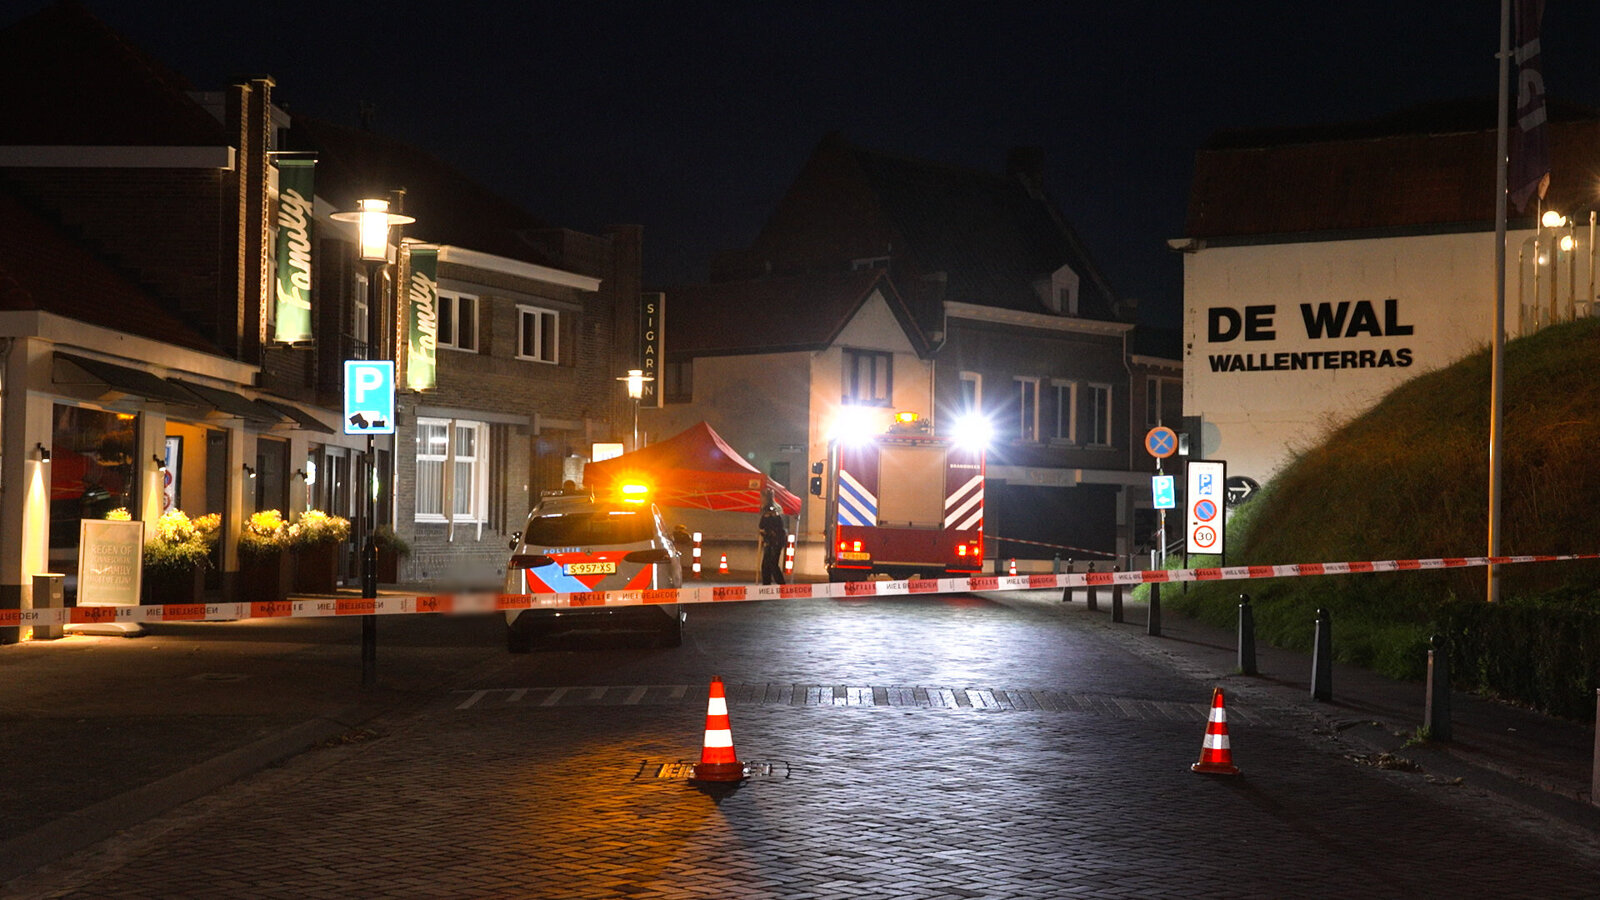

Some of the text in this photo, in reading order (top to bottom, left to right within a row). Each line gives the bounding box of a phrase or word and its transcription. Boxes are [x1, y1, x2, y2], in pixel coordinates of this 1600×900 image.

[277, 188, 313, 310] Family
[408, 271, 437, 366] Family
[1208, 298, 1414, 343] DE WAL
[1208, 348, 1413, 373] WALLENTERRAS
[355, 366, 383, 403] P
[1157, 478, 1170, 494] P
[543, 547, 580, 555] POLITIE
[1198, 532, 1212, 541] 30
